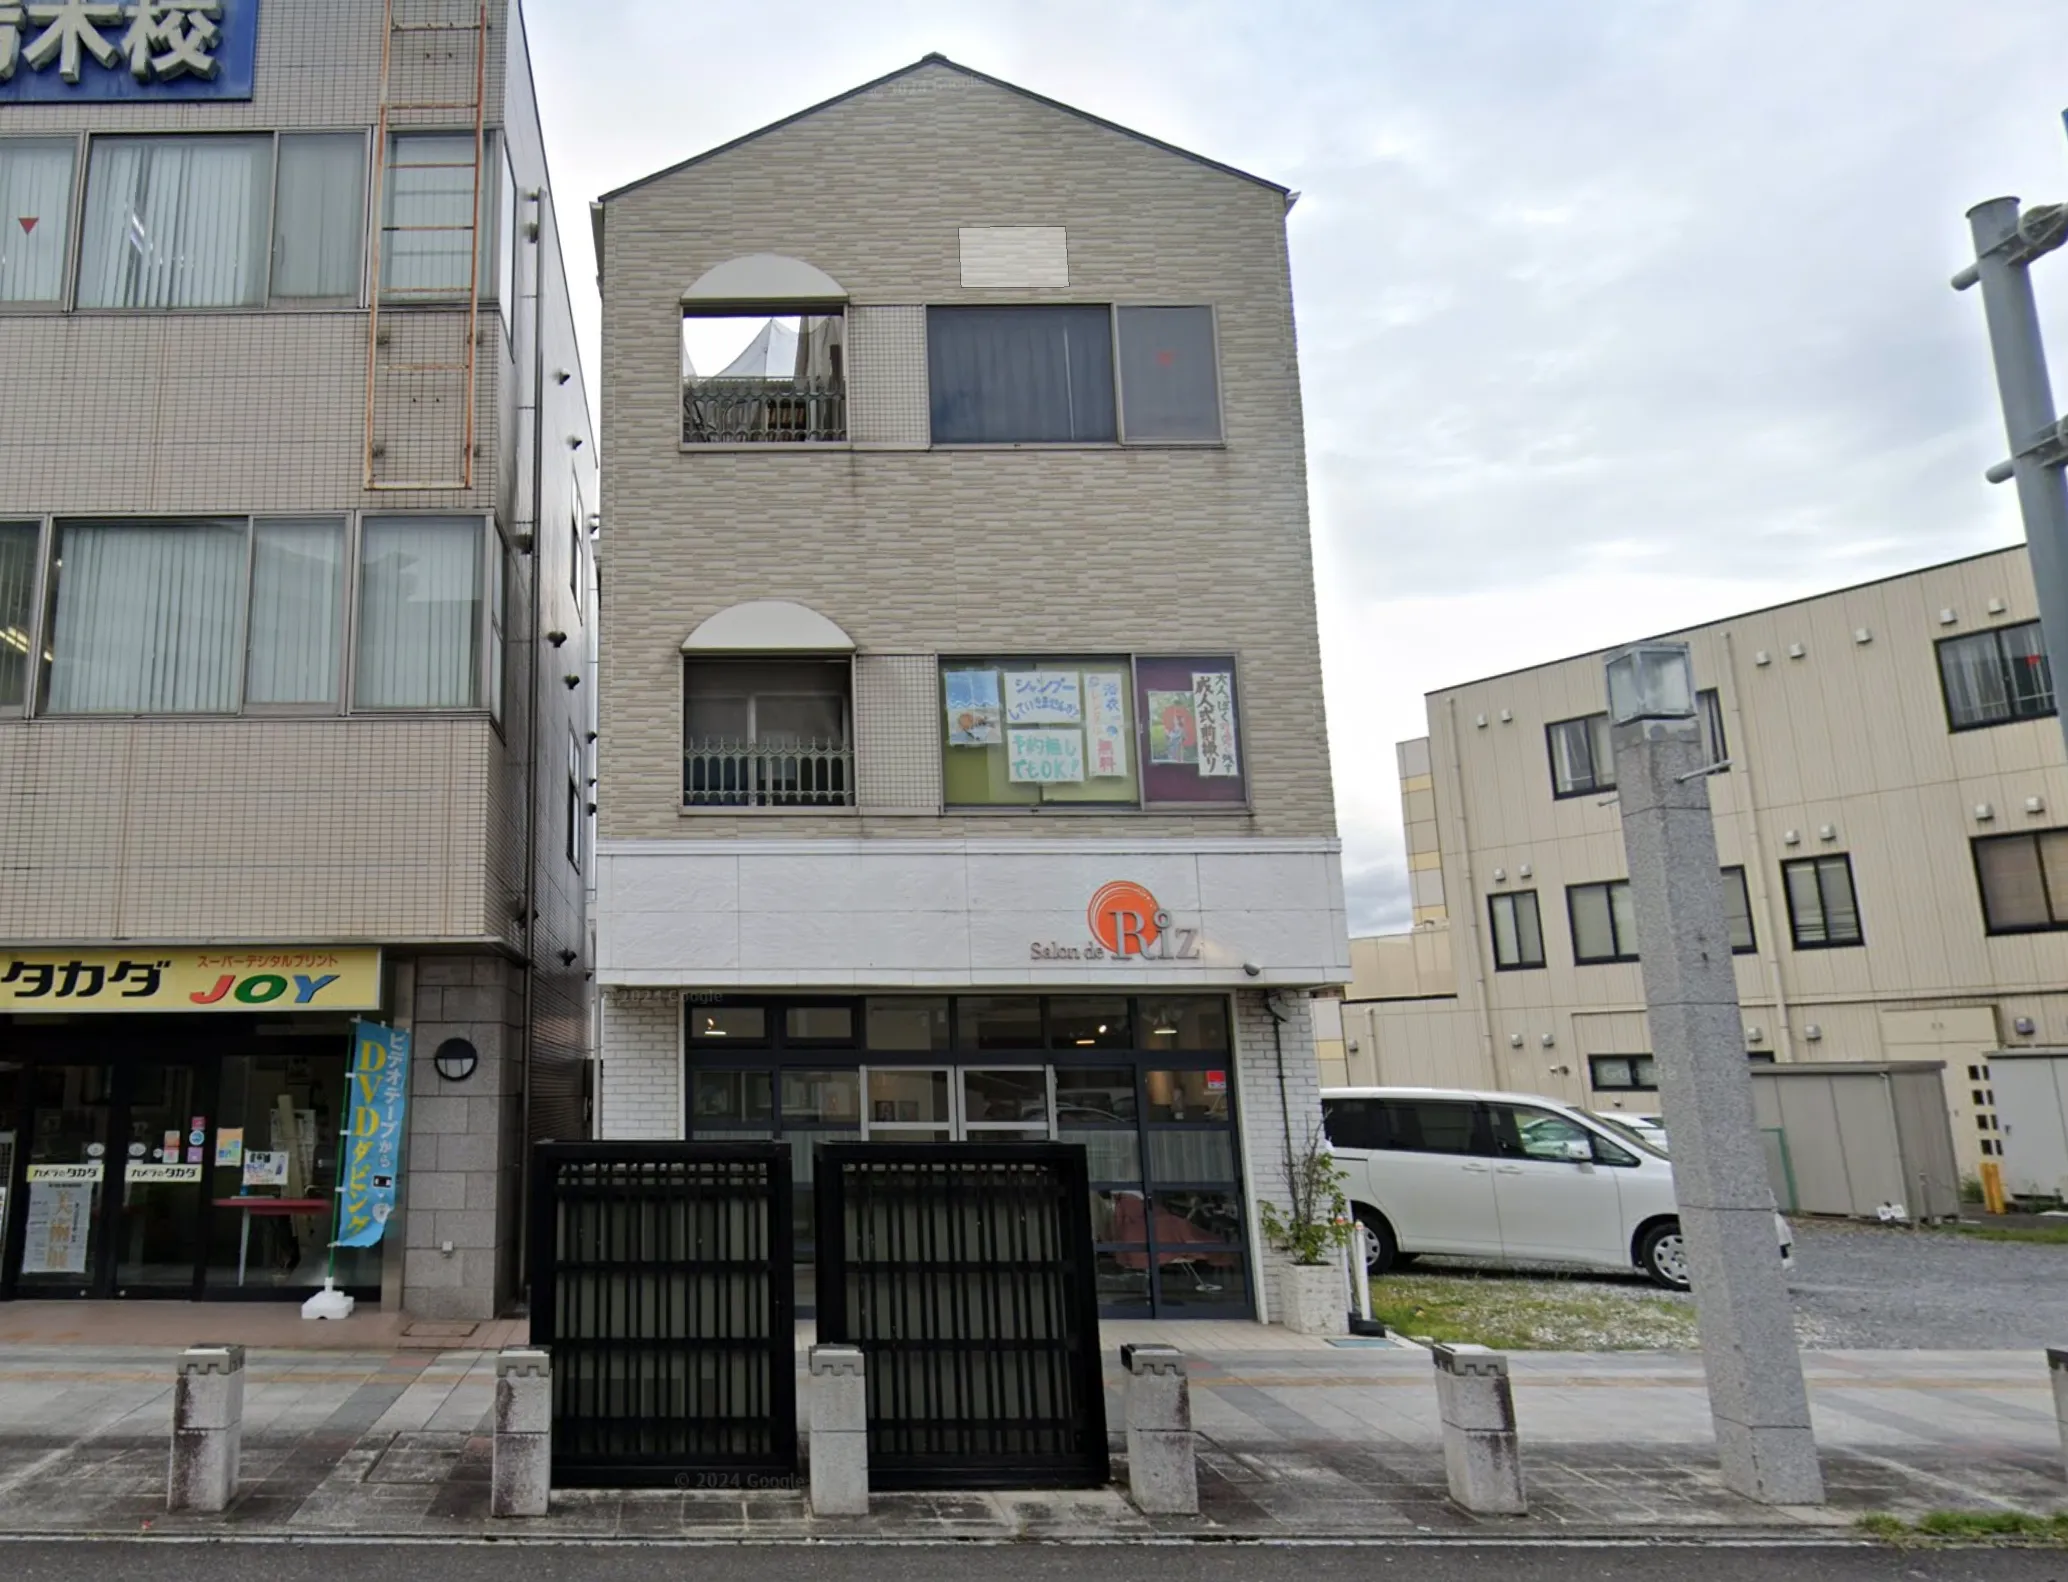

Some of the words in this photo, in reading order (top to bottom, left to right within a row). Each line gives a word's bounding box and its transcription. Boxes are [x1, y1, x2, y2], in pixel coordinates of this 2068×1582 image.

[1030, 942, 1080, 961] Salon
[1083, 941, 1105, 960] de
[1108, 908, 1200, 961] Riz
[0, 960, 171, 998] タカダ
[189, 974, 341, 1004] JOY
[379, 1032, 406, 1168] ビデオテープから
[347, 1039, 387, 1235] DVDダビング
